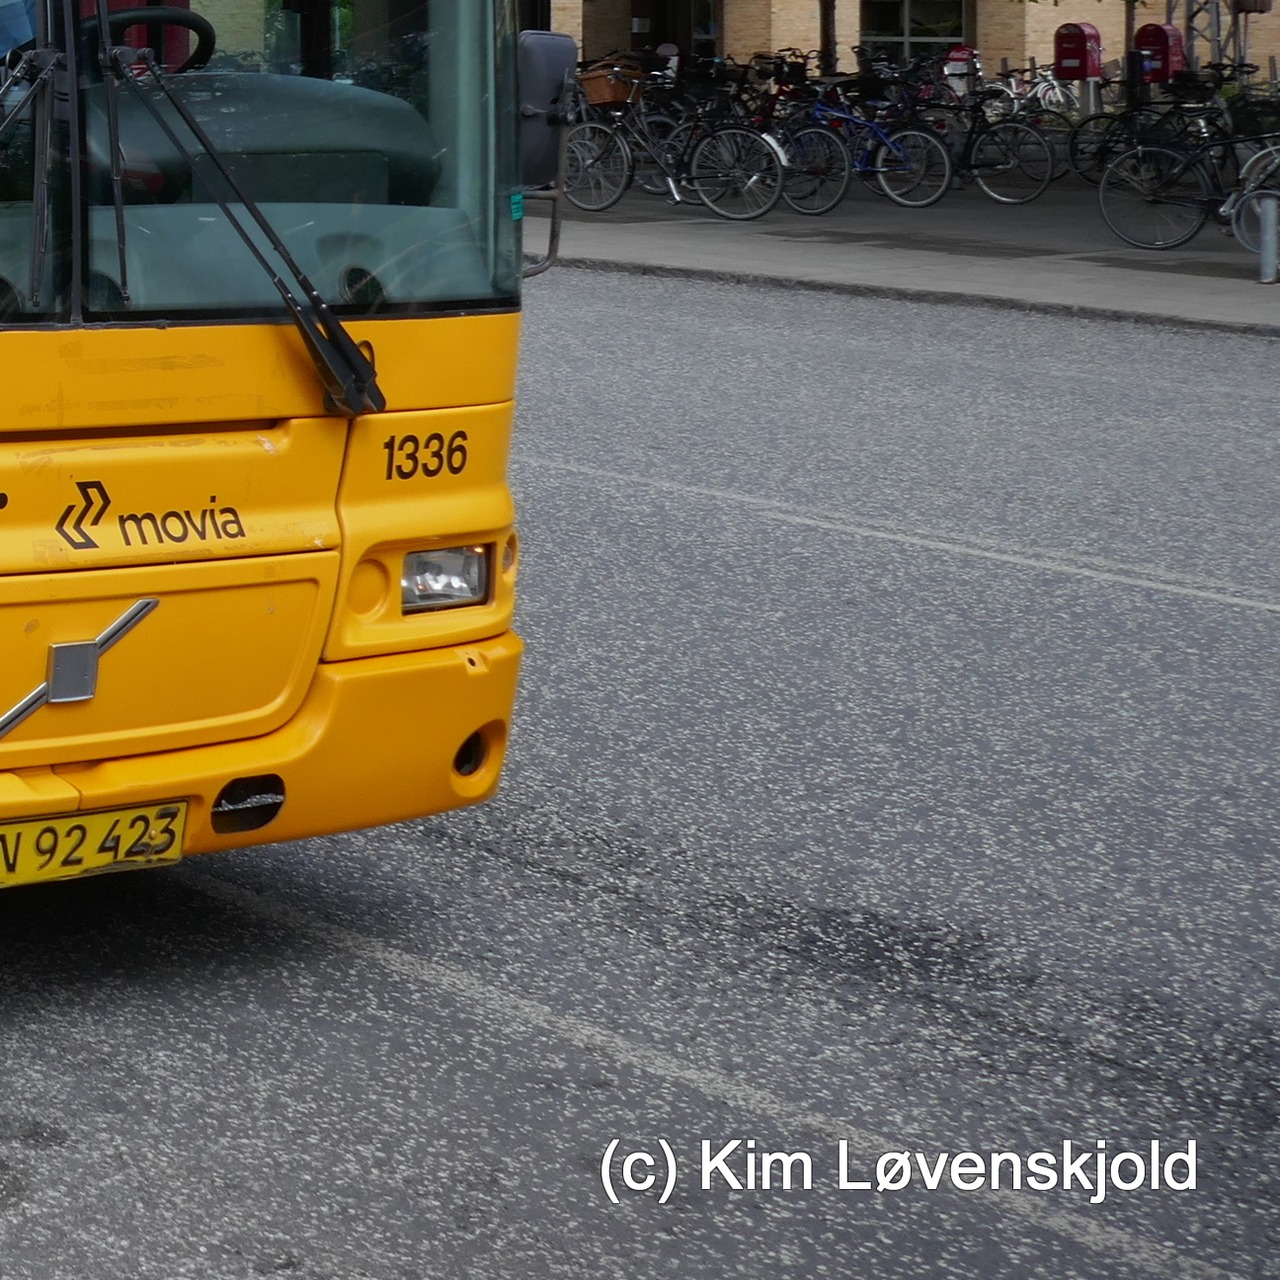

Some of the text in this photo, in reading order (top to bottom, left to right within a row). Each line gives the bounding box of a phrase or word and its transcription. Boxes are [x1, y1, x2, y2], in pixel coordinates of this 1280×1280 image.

[383, 430, 468, 480] 1336
[118, 495, 247, 547] movia
[34, 823, 87, 865] 92
[96, 808, 179, 861] 423
